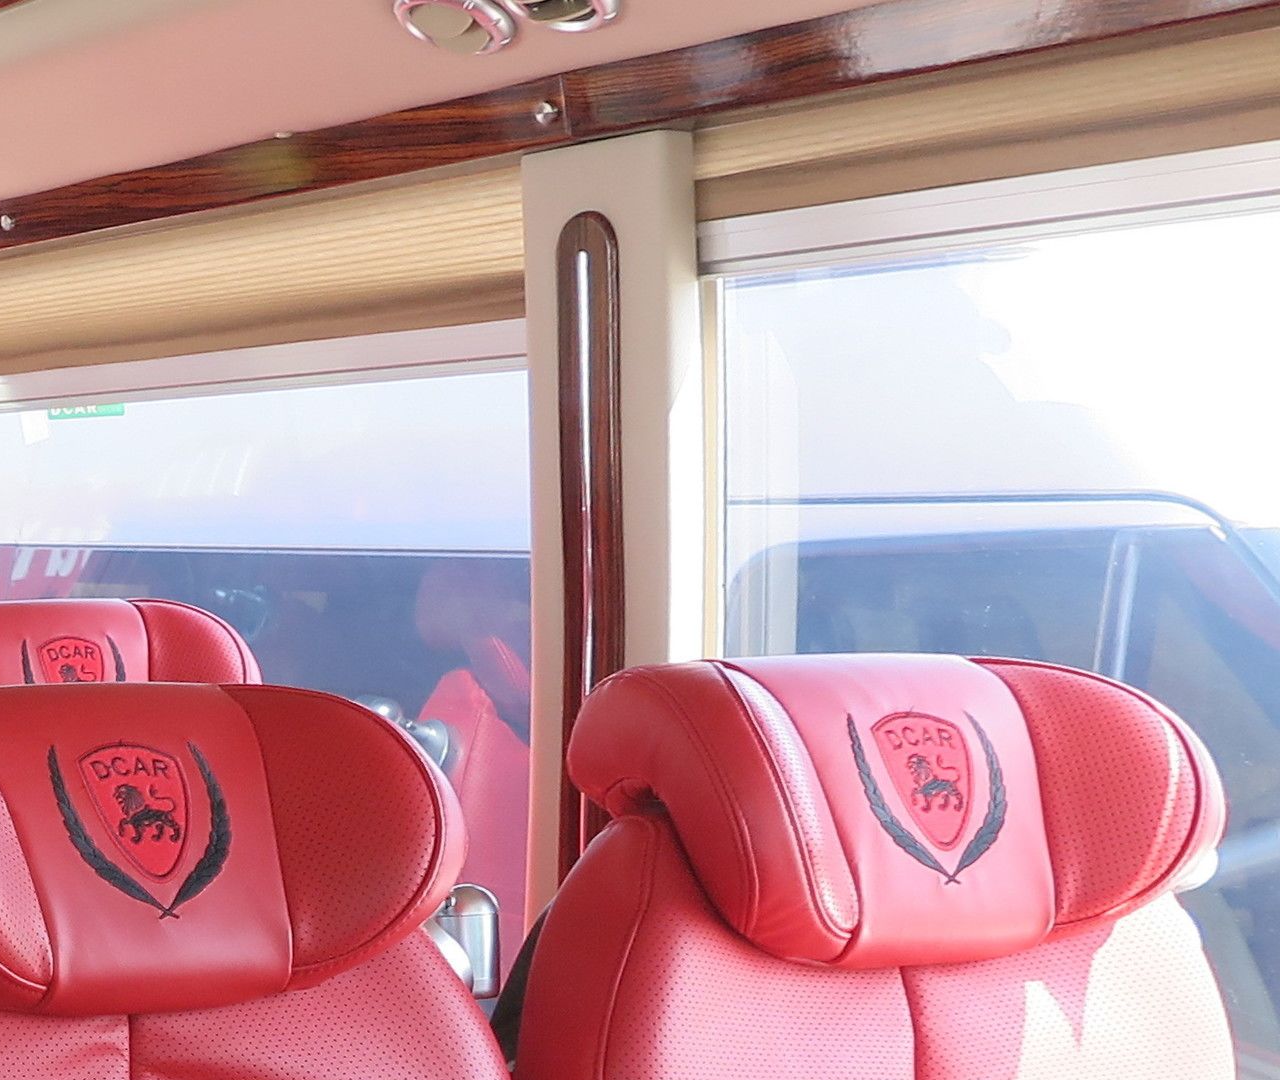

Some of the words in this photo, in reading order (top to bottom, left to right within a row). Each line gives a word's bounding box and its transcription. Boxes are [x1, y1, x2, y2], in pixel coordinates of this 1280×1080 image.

[46, 645, 96, 661] DCAR
[884, 726, 957, 751] DCAR
[90, 756, 169, 780] DCAR
